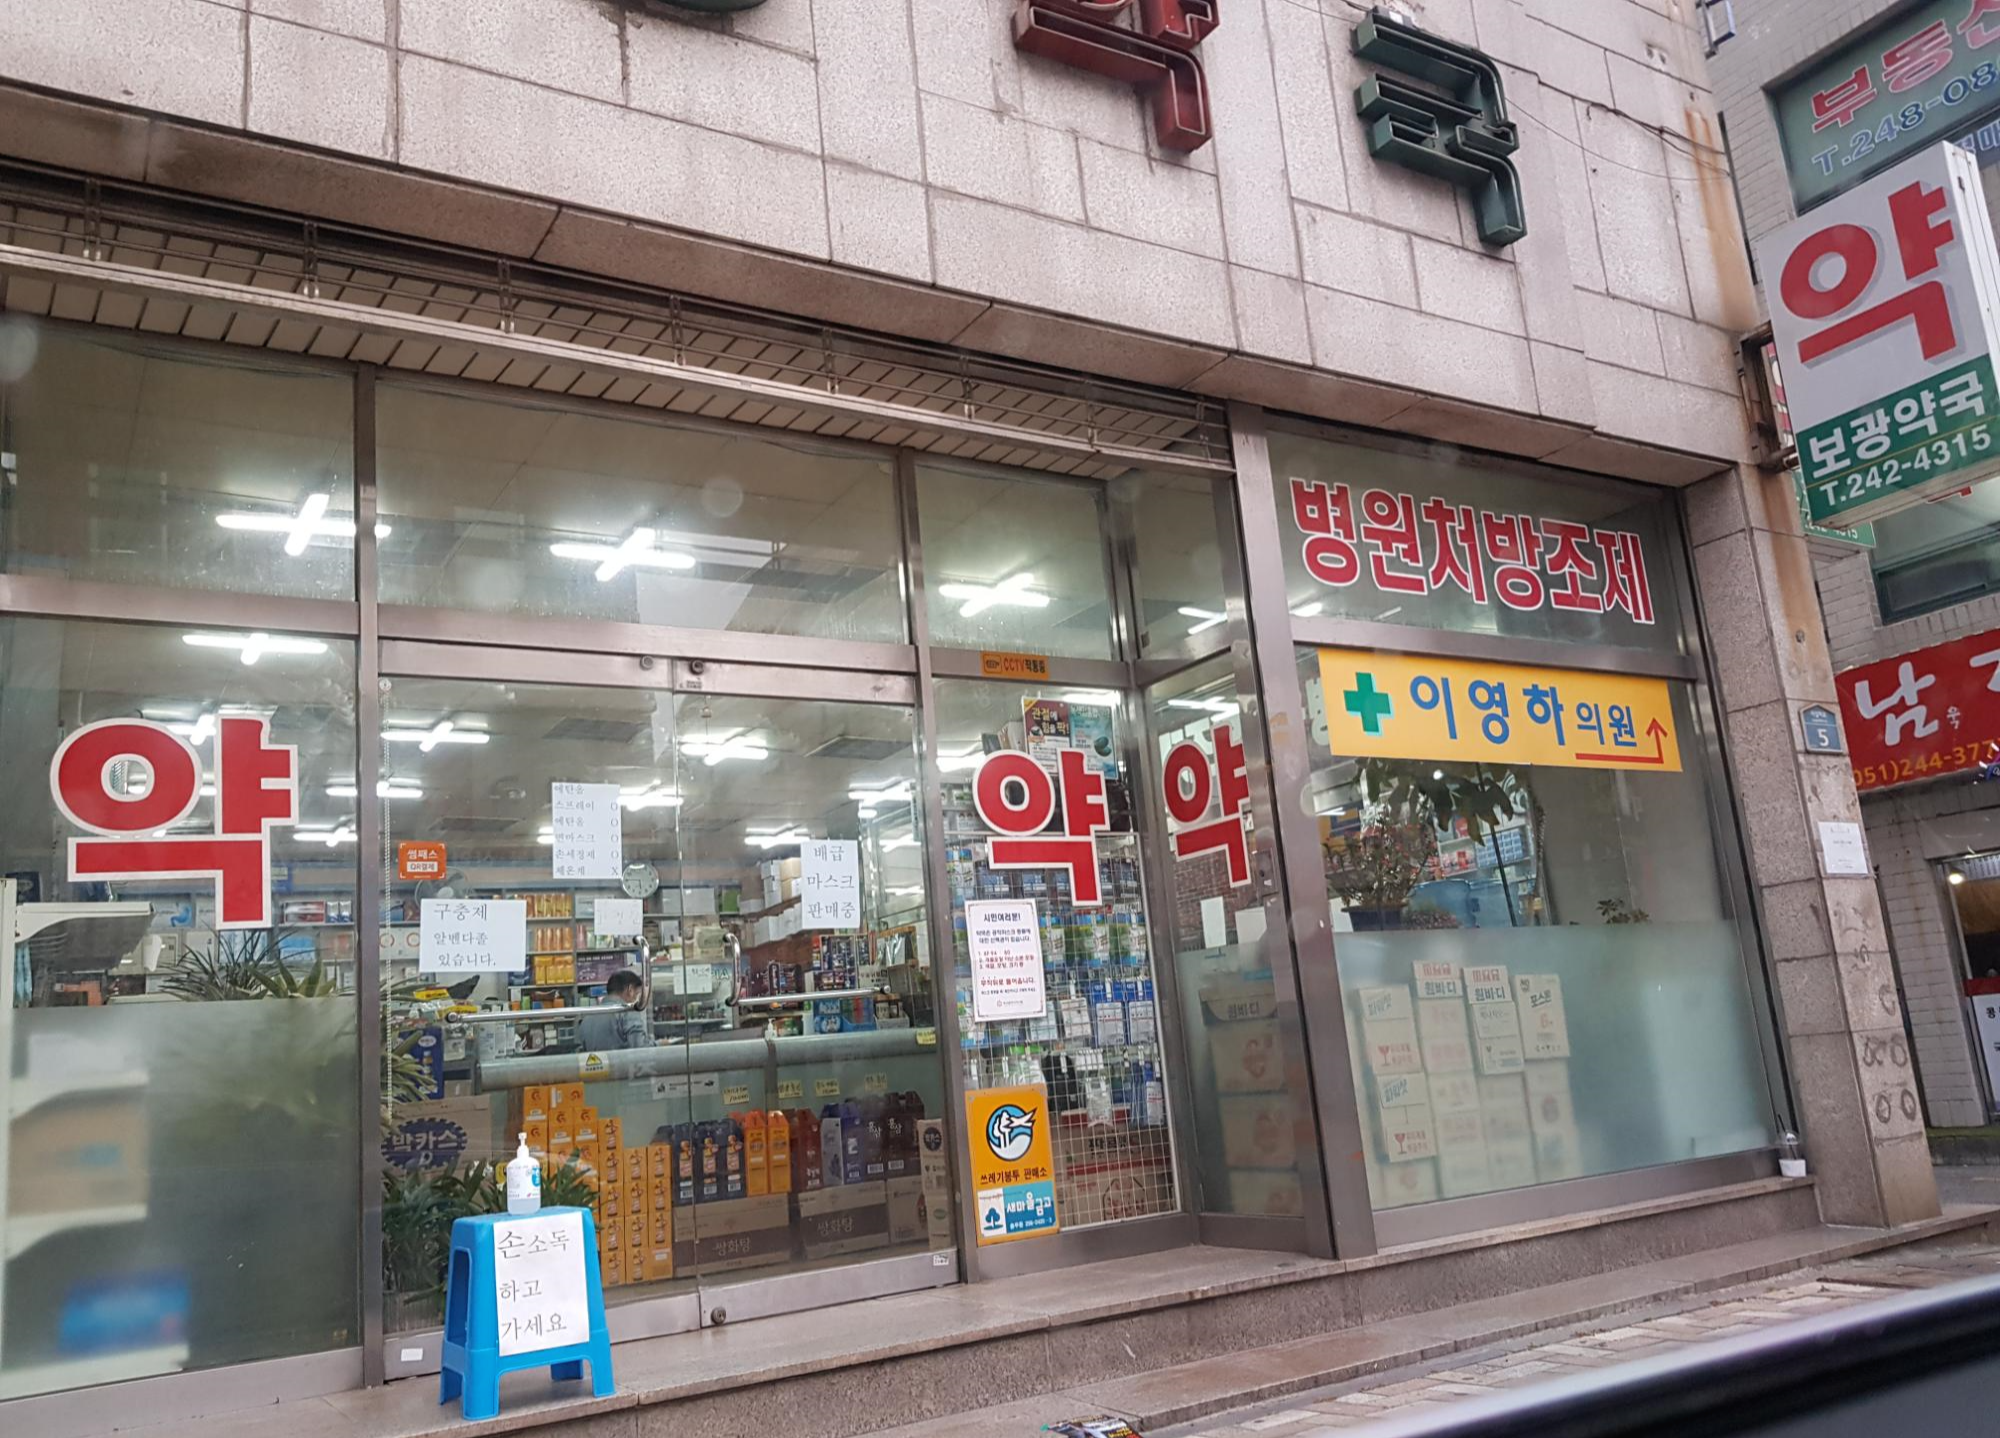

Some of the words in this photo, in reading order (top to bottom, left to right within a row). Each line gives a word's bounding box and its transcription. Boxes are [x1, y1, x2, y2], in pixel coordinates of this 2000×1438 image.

[1780, 180, 1960, 362] 약
[1809, 370, 1985, 479] 보광약국
[1819, 423, 1992, 506] T.242-4315
[1289, 477, 1655, 624] 병원처방조제
[1817, 728, 1829, 747] 5
[1162, 722, 1251, 888] 약
[50, 714, 299, 930] 약
[972, 748, 1110, 907] 약
[814, 844, 845, 862] 배급
[807, 873, 855, 890] 마스크
[433, 903, 487, 921] 구충제
[808, 901, 856, 919] 판매중
[433, 931, 488, 946] 알벤다졸
[438, 953, 496, 967] 있습니다.
[392, 1130, 458, 1152] 박카스
[980, 1170, 1020, 1185] 쓰레기봉투
[1024, 1167, 1048, 1181] 판매소
[1007, 1191, 1051, 1217] 새마을금고
[497, 1230, 570, 1260] 손소독
[499, 1279, 542, 1303] 하고
[501, 1312, 567, 1342] 가세요
